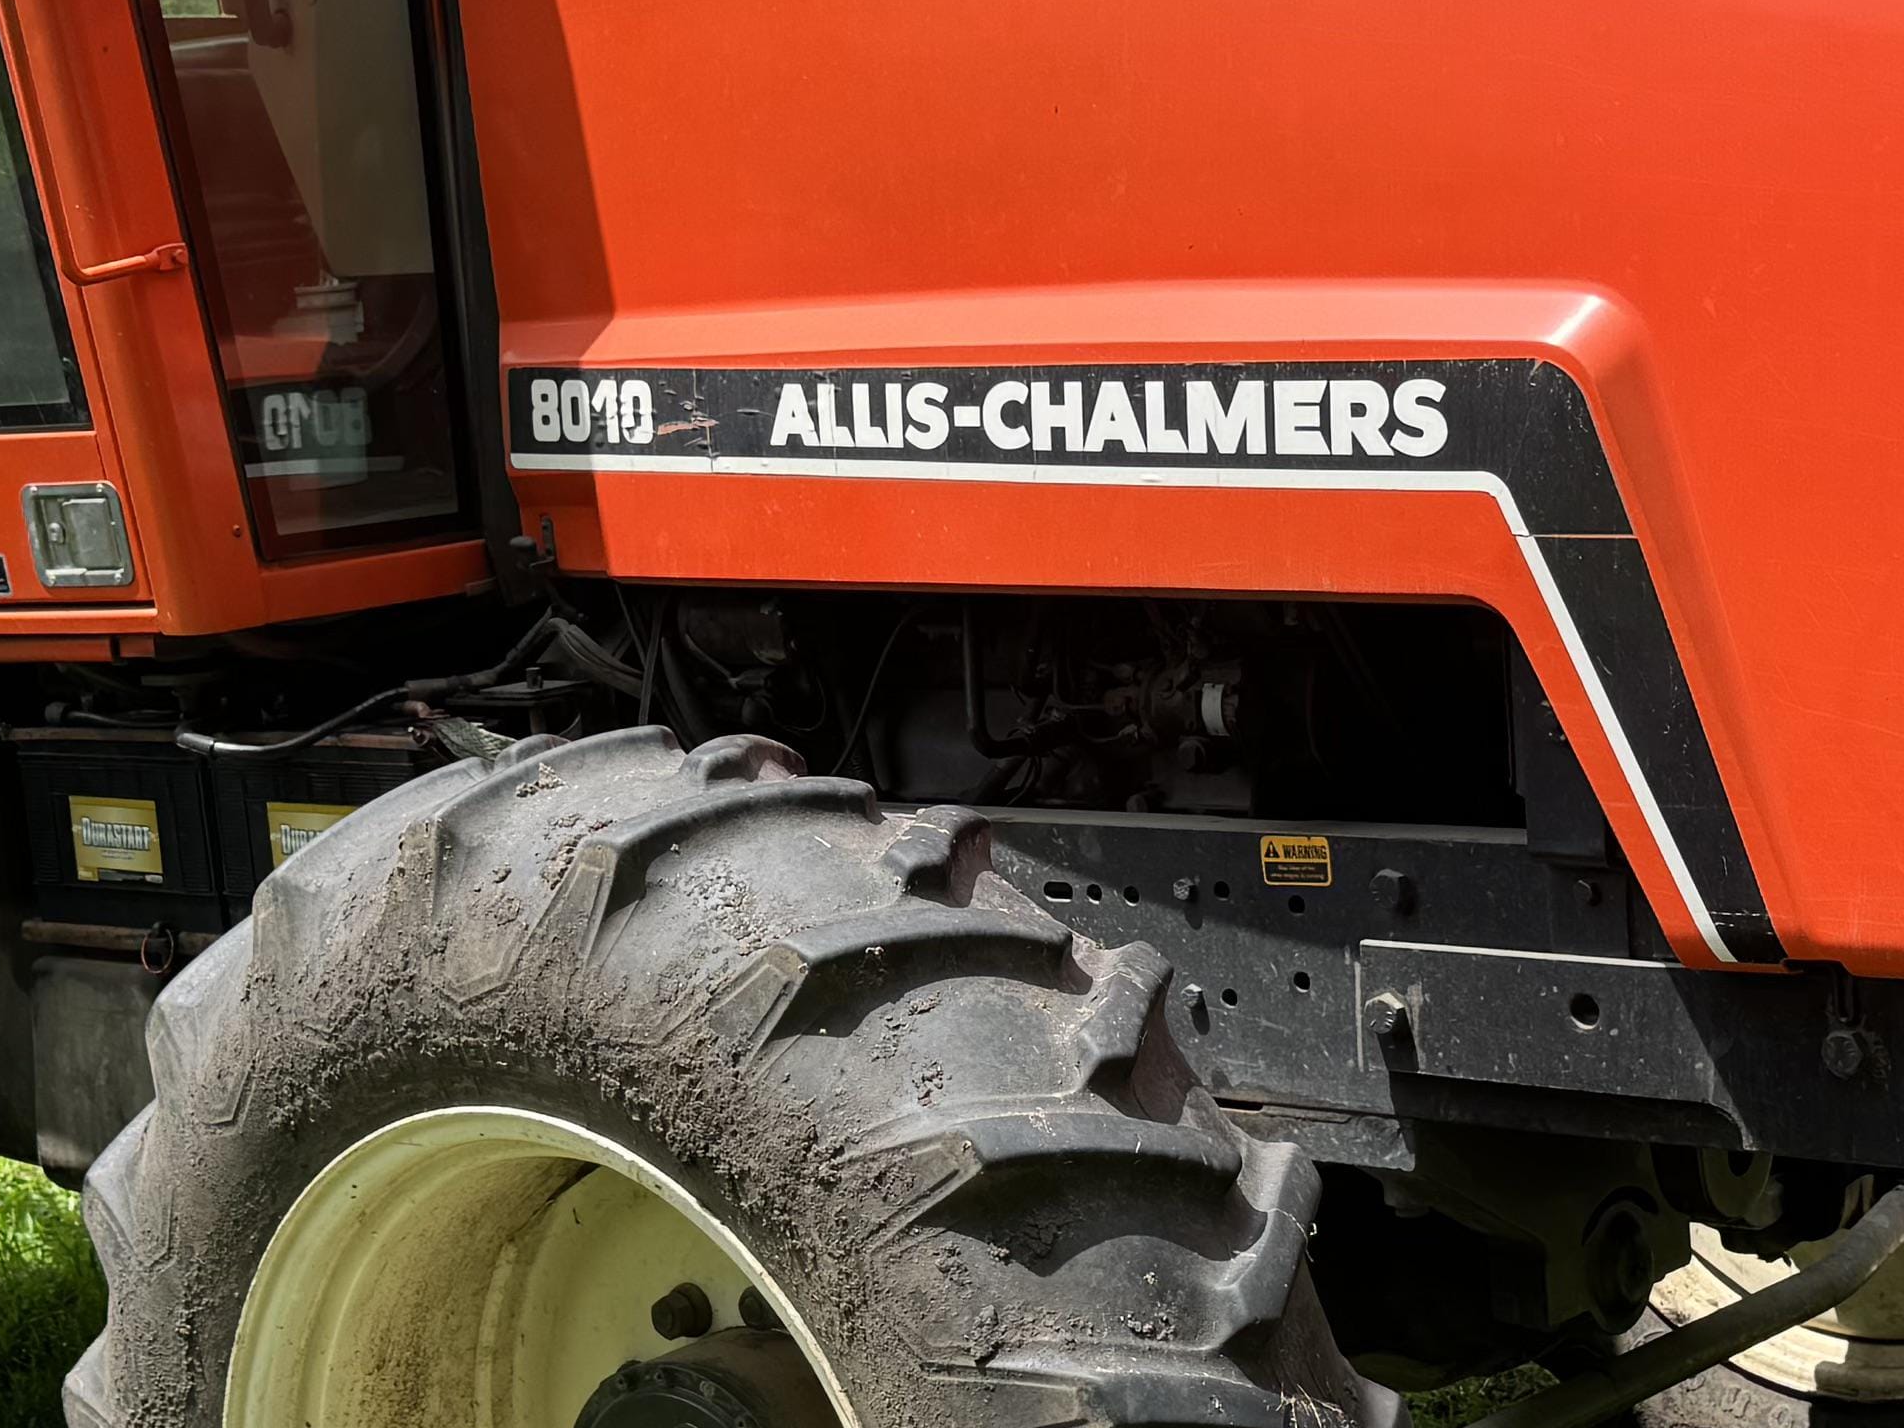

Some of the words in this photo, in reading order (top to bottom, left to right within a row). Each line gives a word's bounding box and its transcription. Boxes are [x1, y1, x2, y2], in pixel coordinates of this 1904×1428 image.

[531, 378, 654, 444] 8010
[769, 378, 1449, 457] ALLIS-CHALMERS
[1282, 844, 1328, 860] WARNING
